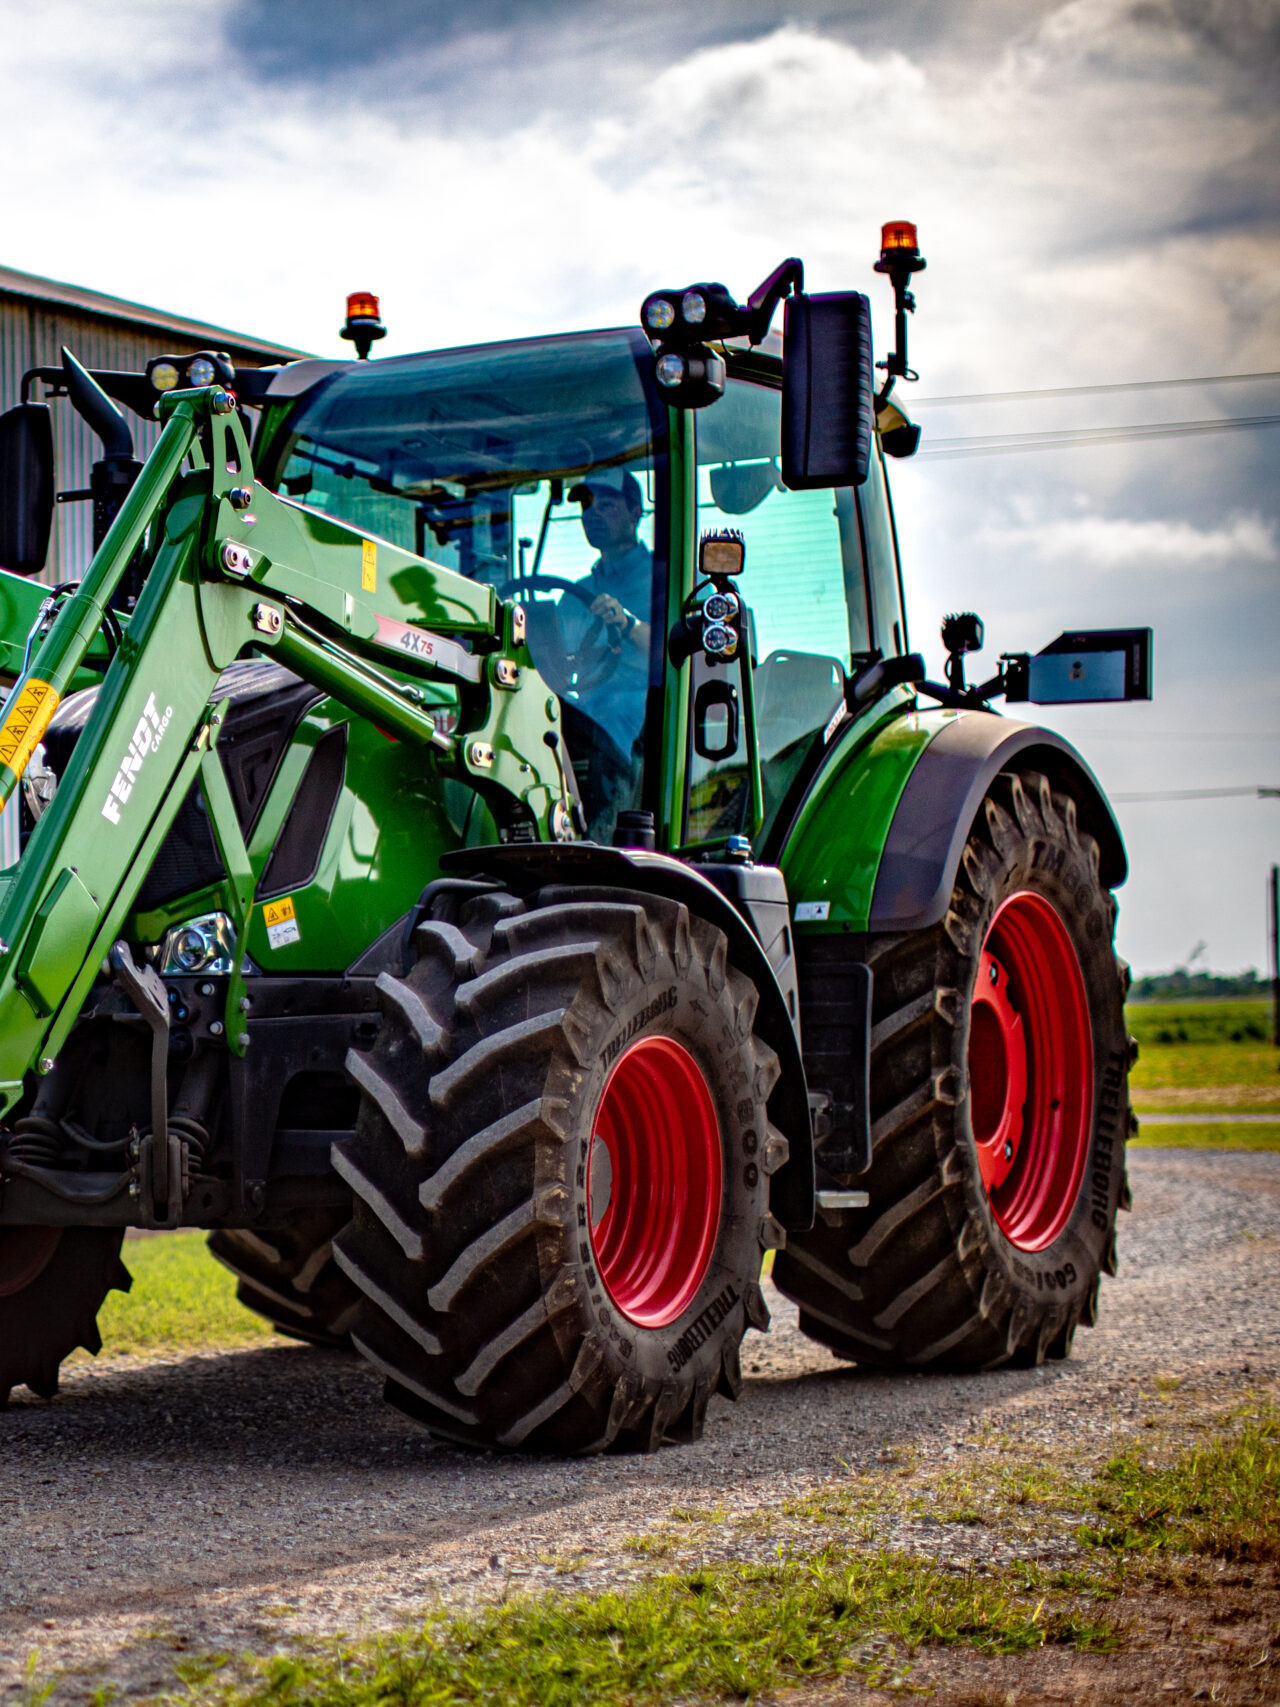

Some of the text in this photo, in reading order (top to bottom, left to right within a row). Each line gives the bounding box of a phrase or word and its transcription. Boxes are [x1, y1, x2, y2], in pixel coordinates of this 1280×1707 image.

[101, 691, 160, 825] FENDT
[151, 706, 173, 752] CARGO
[598, 985, 677, 1072] TRELLEBORG
[1091, 1051, 1125, 1233] TRELLEBORG
[667, 1283, 740, 1373] TRELLEBORG
